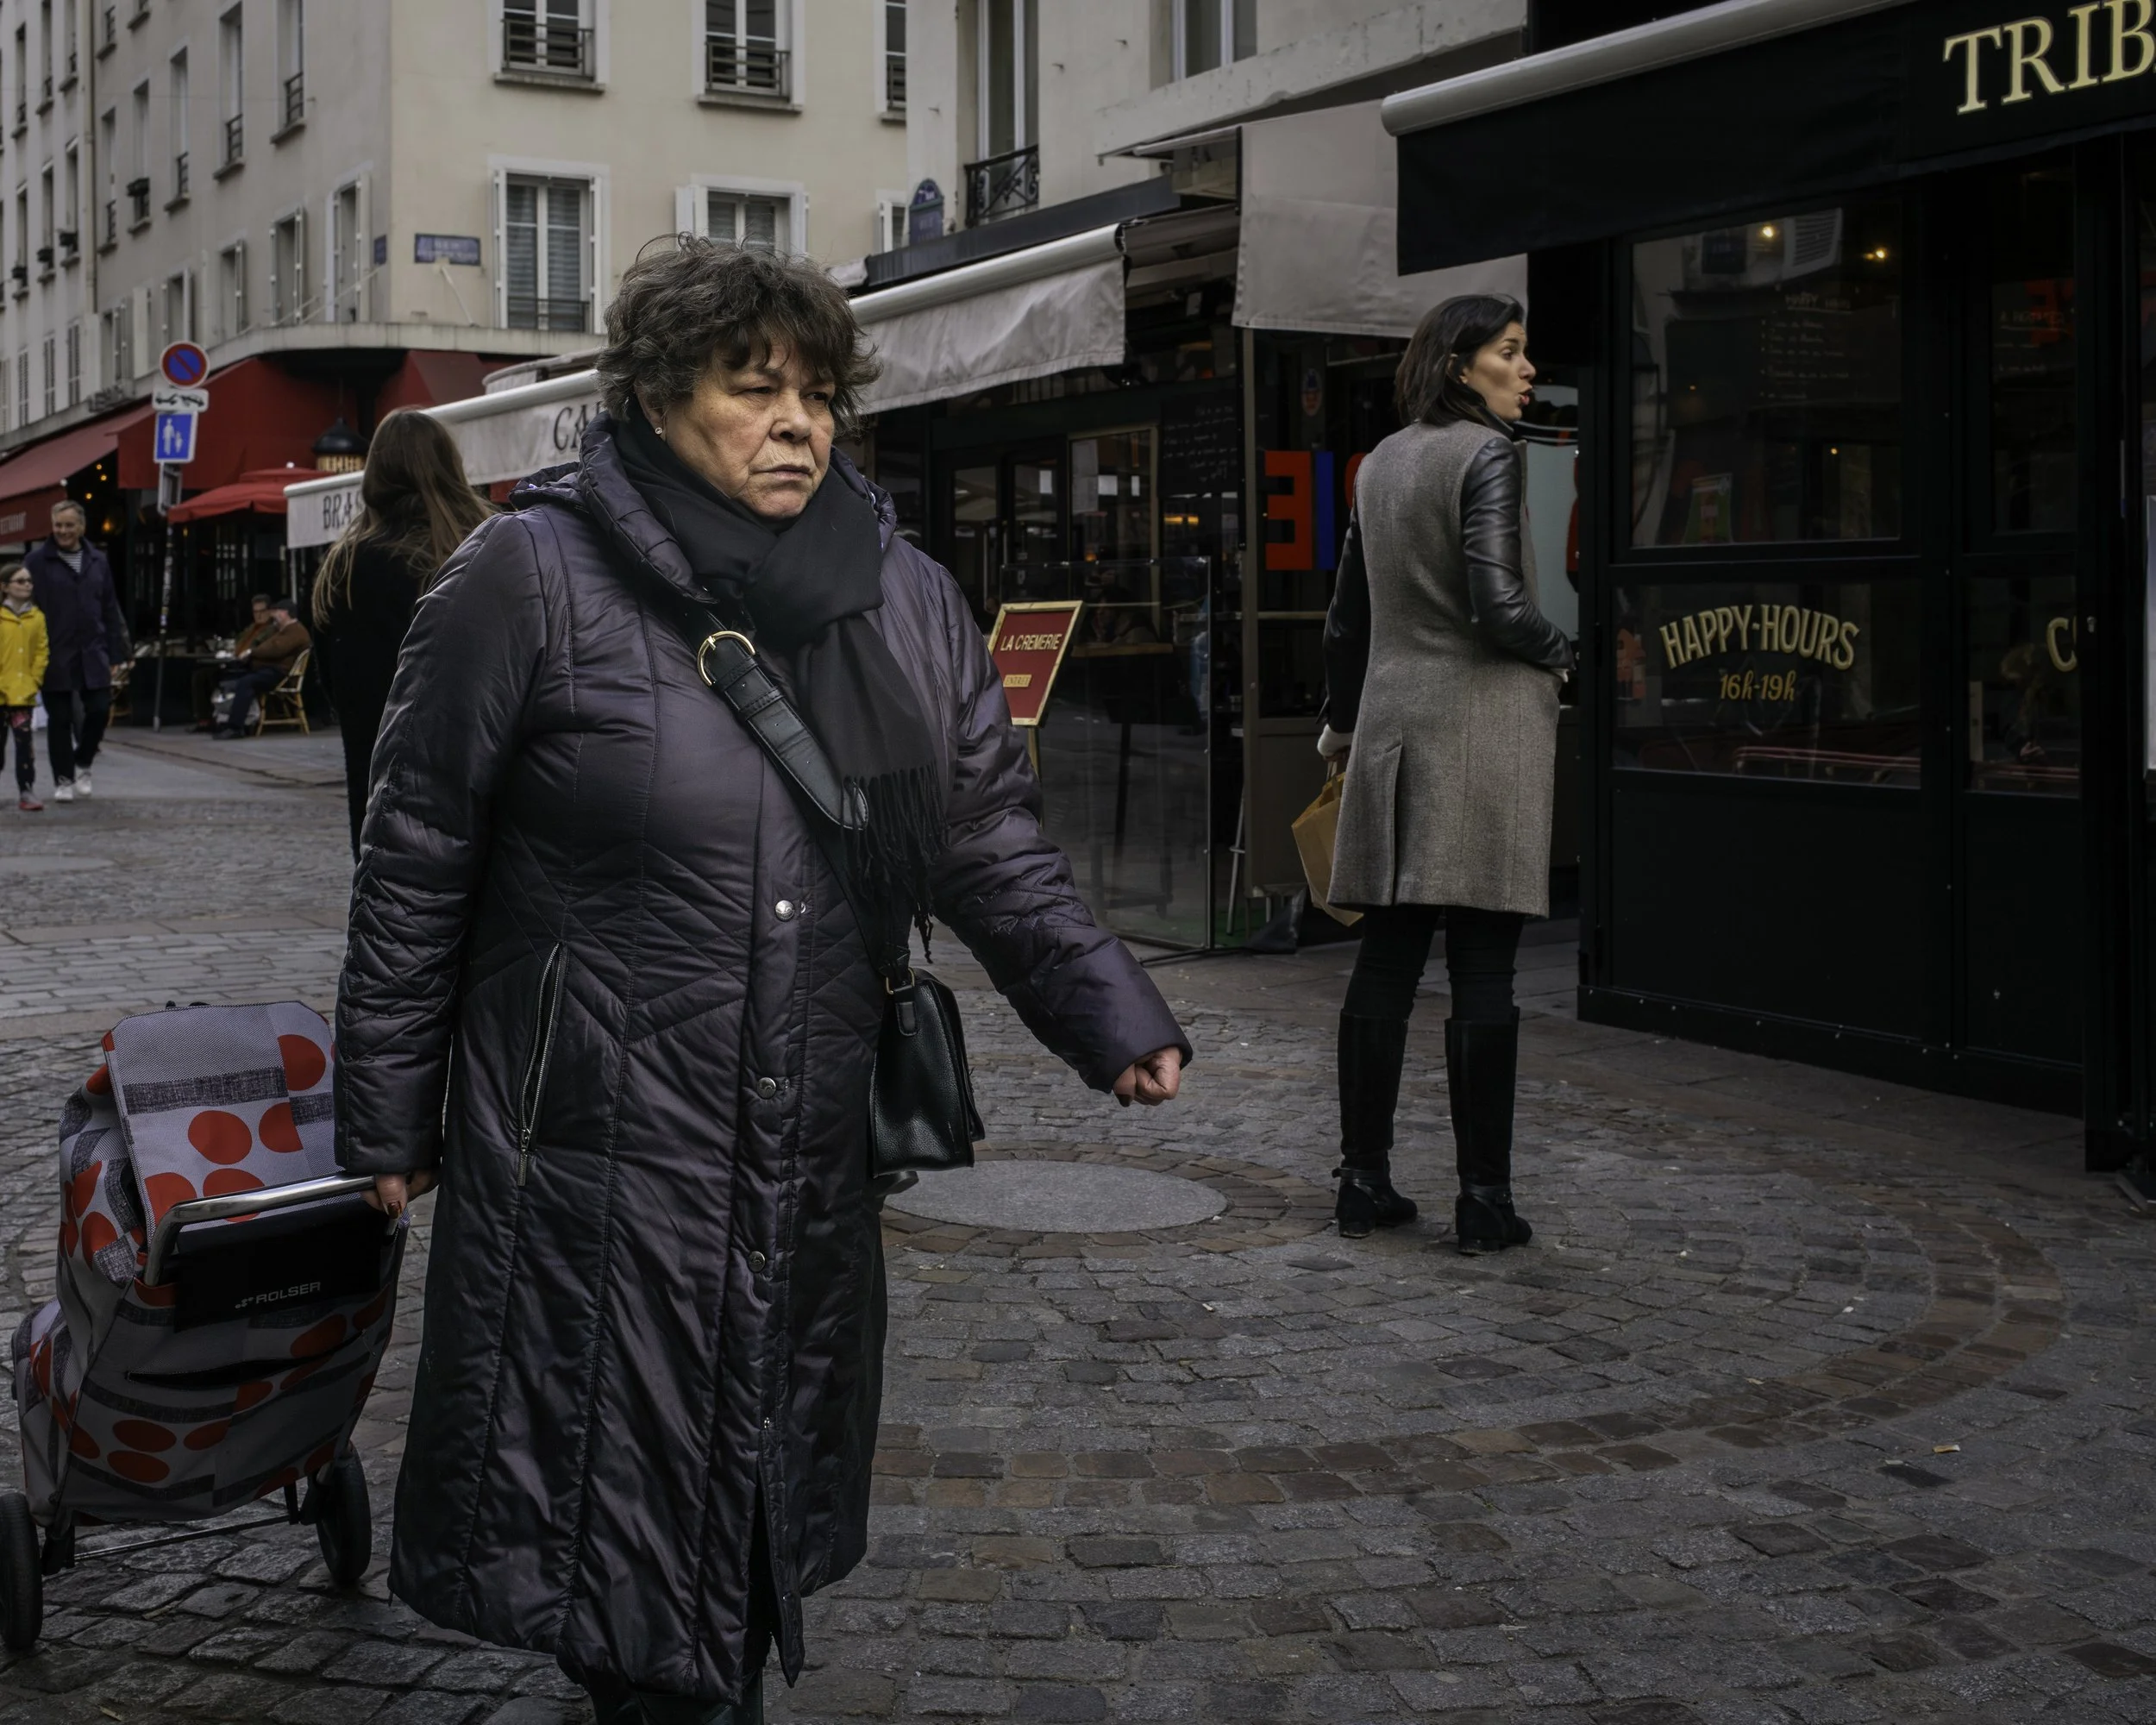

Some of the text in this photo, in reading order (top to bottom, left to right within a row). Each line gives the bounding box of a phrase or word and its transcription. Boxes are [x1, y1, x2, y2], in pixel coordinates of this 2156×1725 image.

[554, 401, 602, 451] CA
[1000, 633, 1062, 651] LA CREMERIE
[1659, 604, 1860, 670] HAPPY-HOURS
[2046, 615, 2078, 673] C
[1720, 669, 1798, 701] 16h-19h
[255, 1281, 322, 1304] ROLSER
